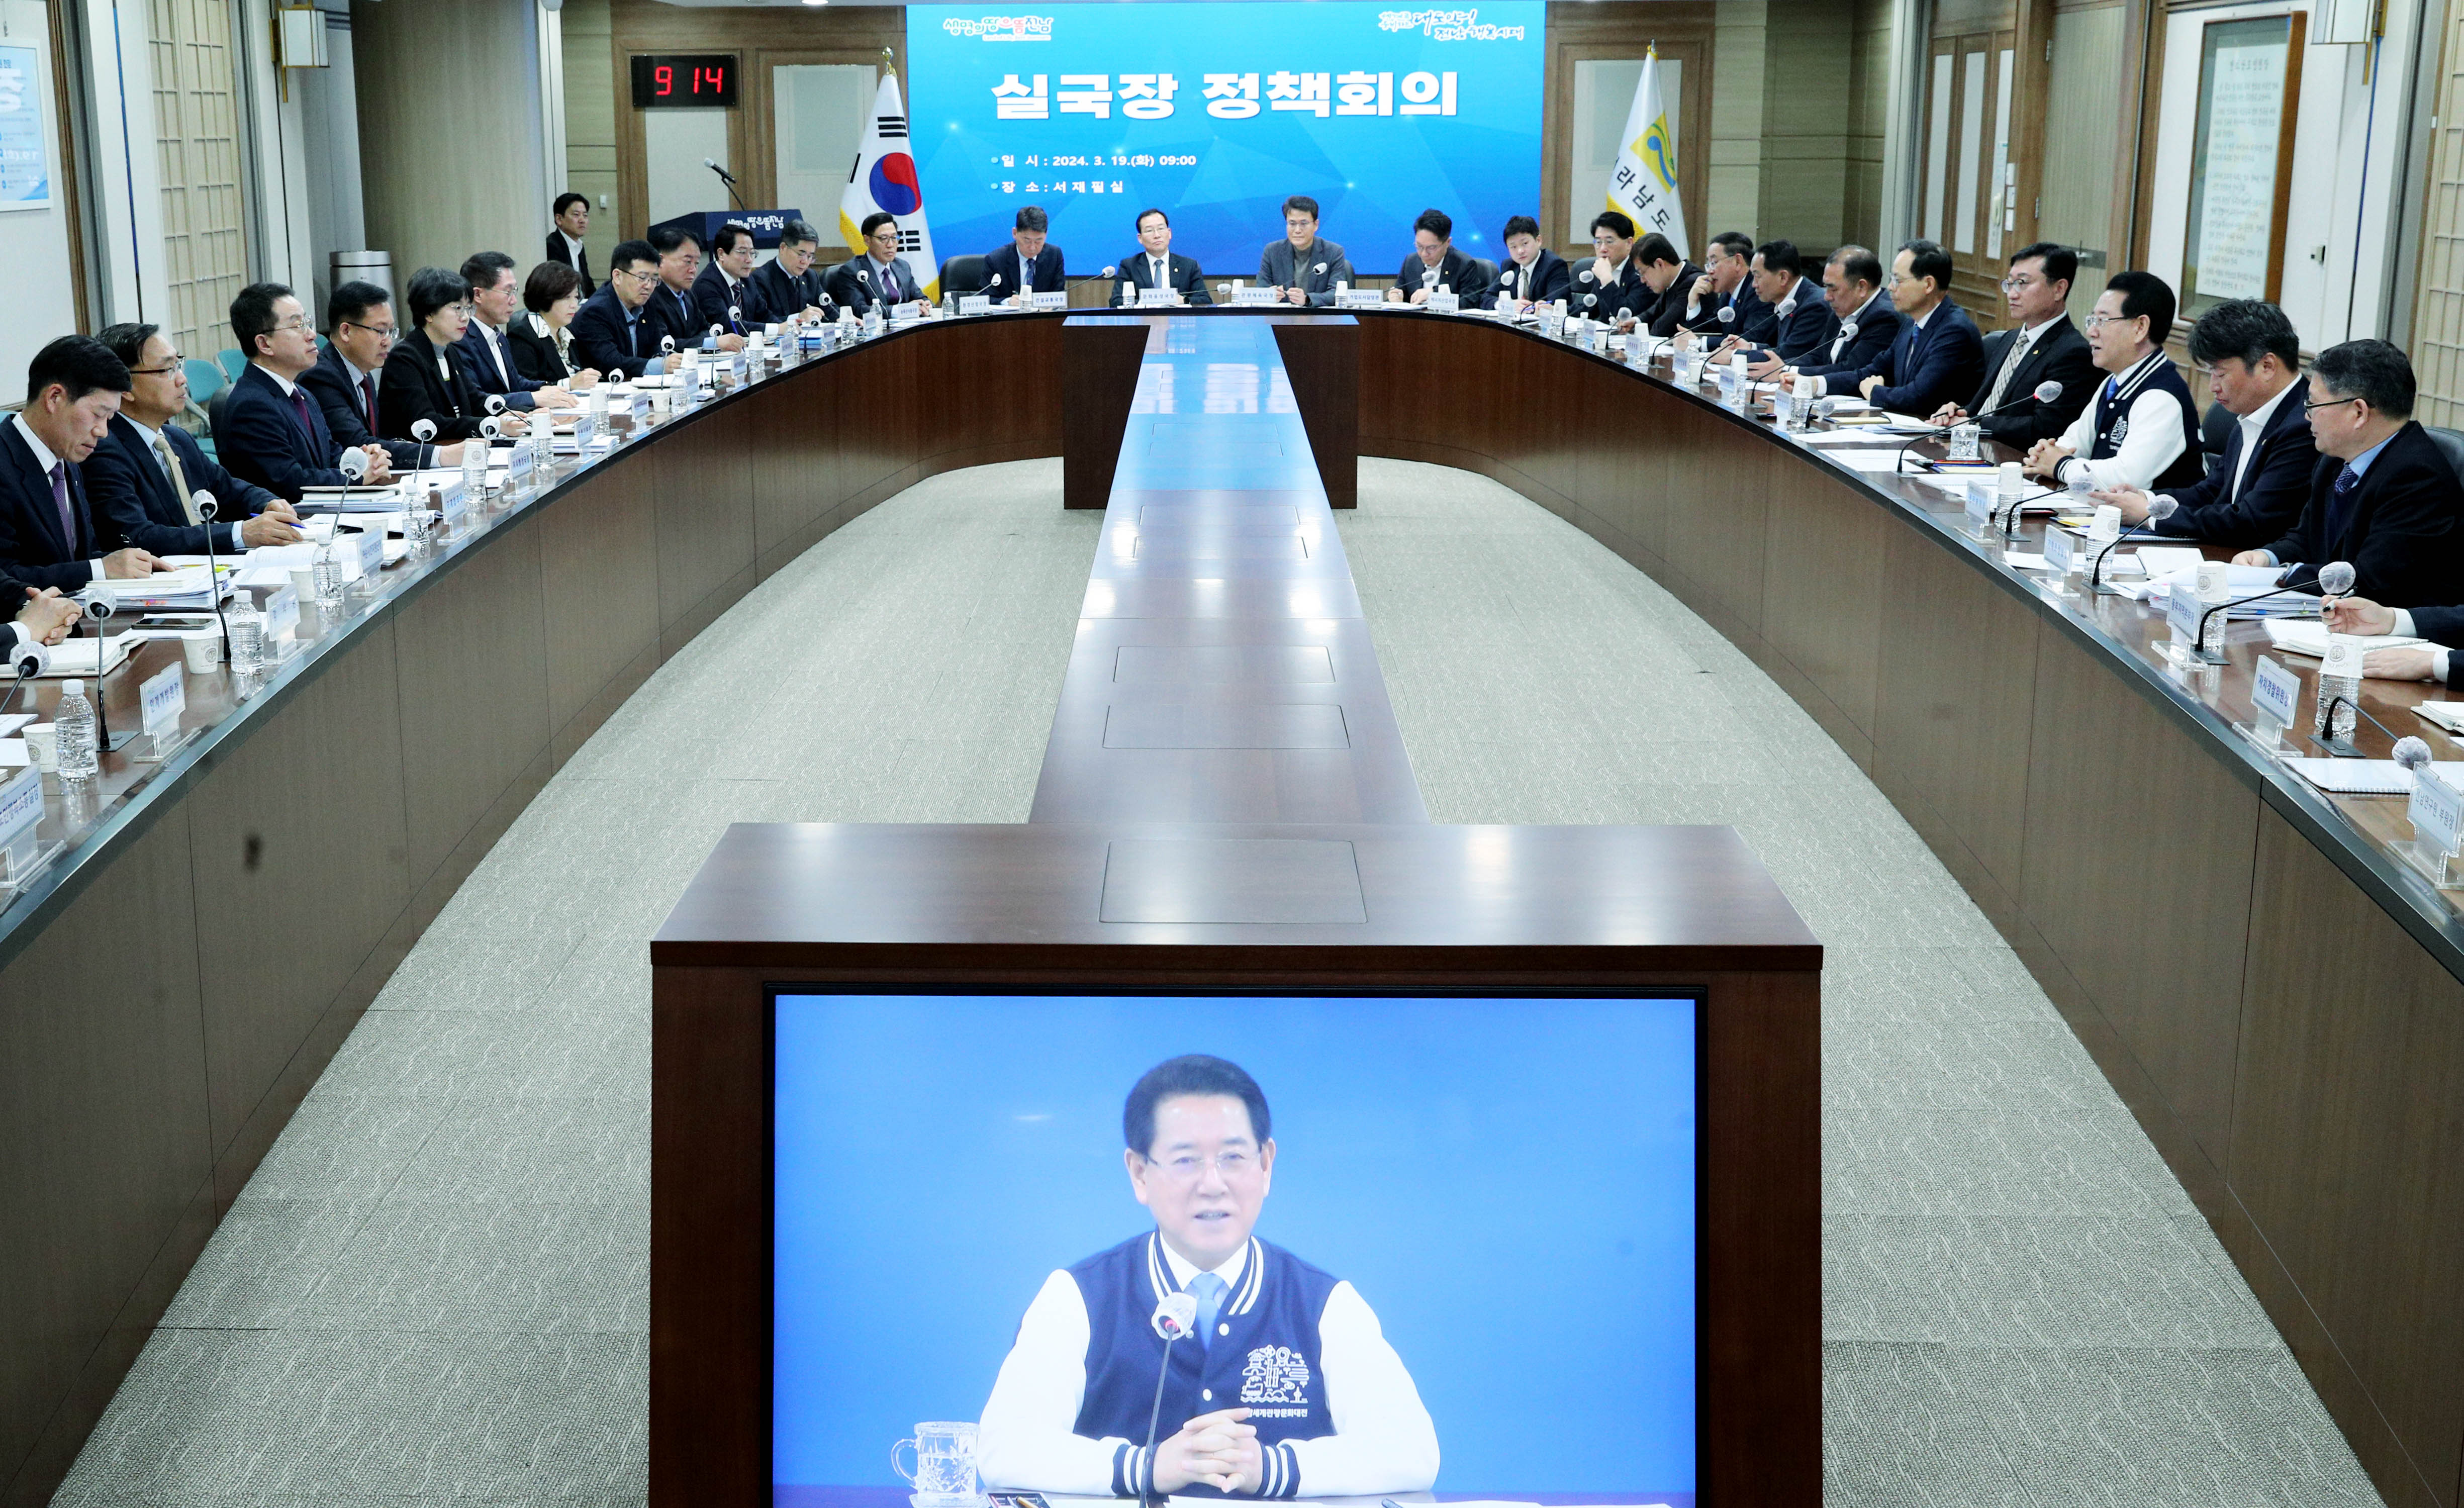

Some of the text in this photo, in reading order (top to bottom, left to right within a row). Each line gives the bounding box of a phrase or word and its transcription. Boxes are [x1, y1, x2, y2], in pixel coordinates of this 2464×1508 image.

[654, 66, 723, 95] 9 14
[991, 71, 1457, 119] 실국장 정책회의
[1053, 156, 1089, 166] 2024.
[1094, 156, 1105, 165] 3.
[1111, 154, 1155, 167] 19.(화)
[1159, 155, 1196, 165] 09:00
[1614, 157, 1670, 232] 라남도
[2438, 807, 2454, 830] 부원장
